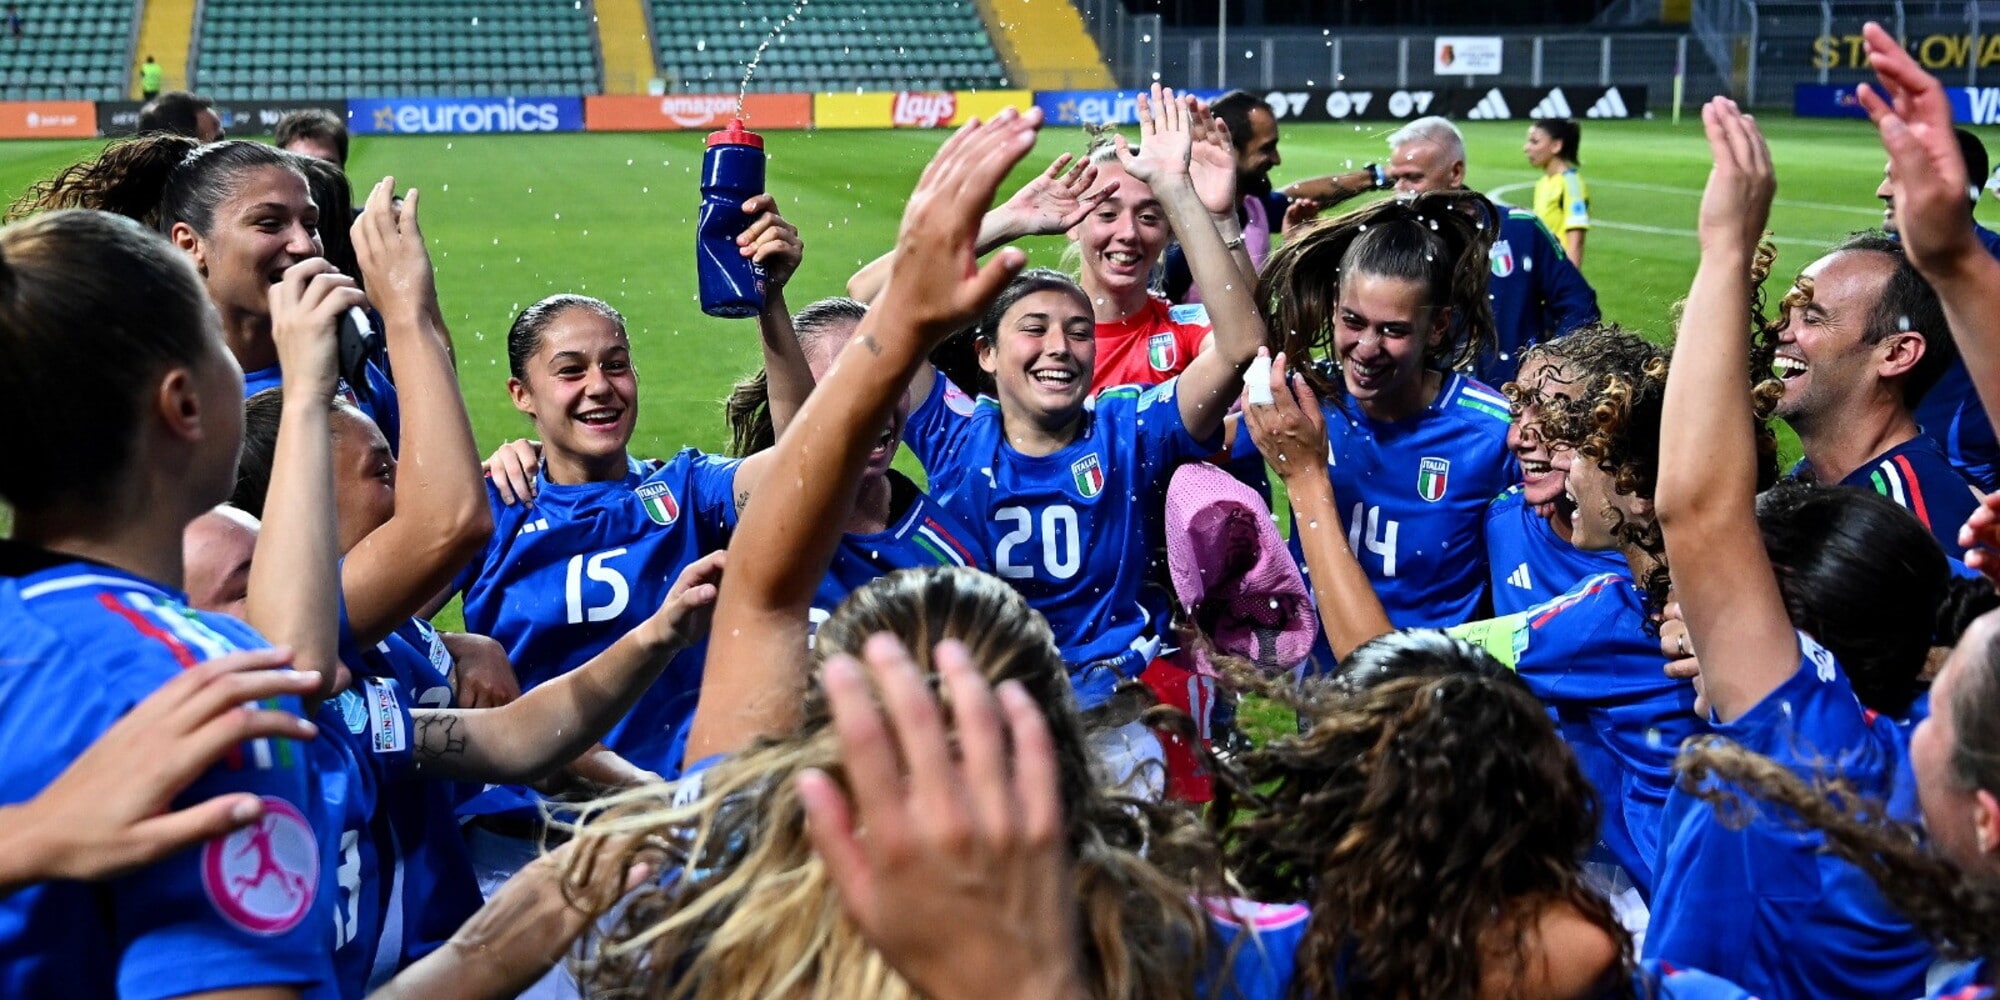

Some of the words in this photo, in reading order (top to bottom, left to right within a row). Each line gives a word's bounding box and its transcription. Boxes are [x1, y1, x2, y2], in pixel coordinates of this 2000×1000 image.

[396, 97, 559, 123] euronics
[661, 97, 739, 115] amazon
[995, 504, 1080, 579] 20
[1347, 502, 1400, 577] 14
[566, 547, 629, 624] 15
